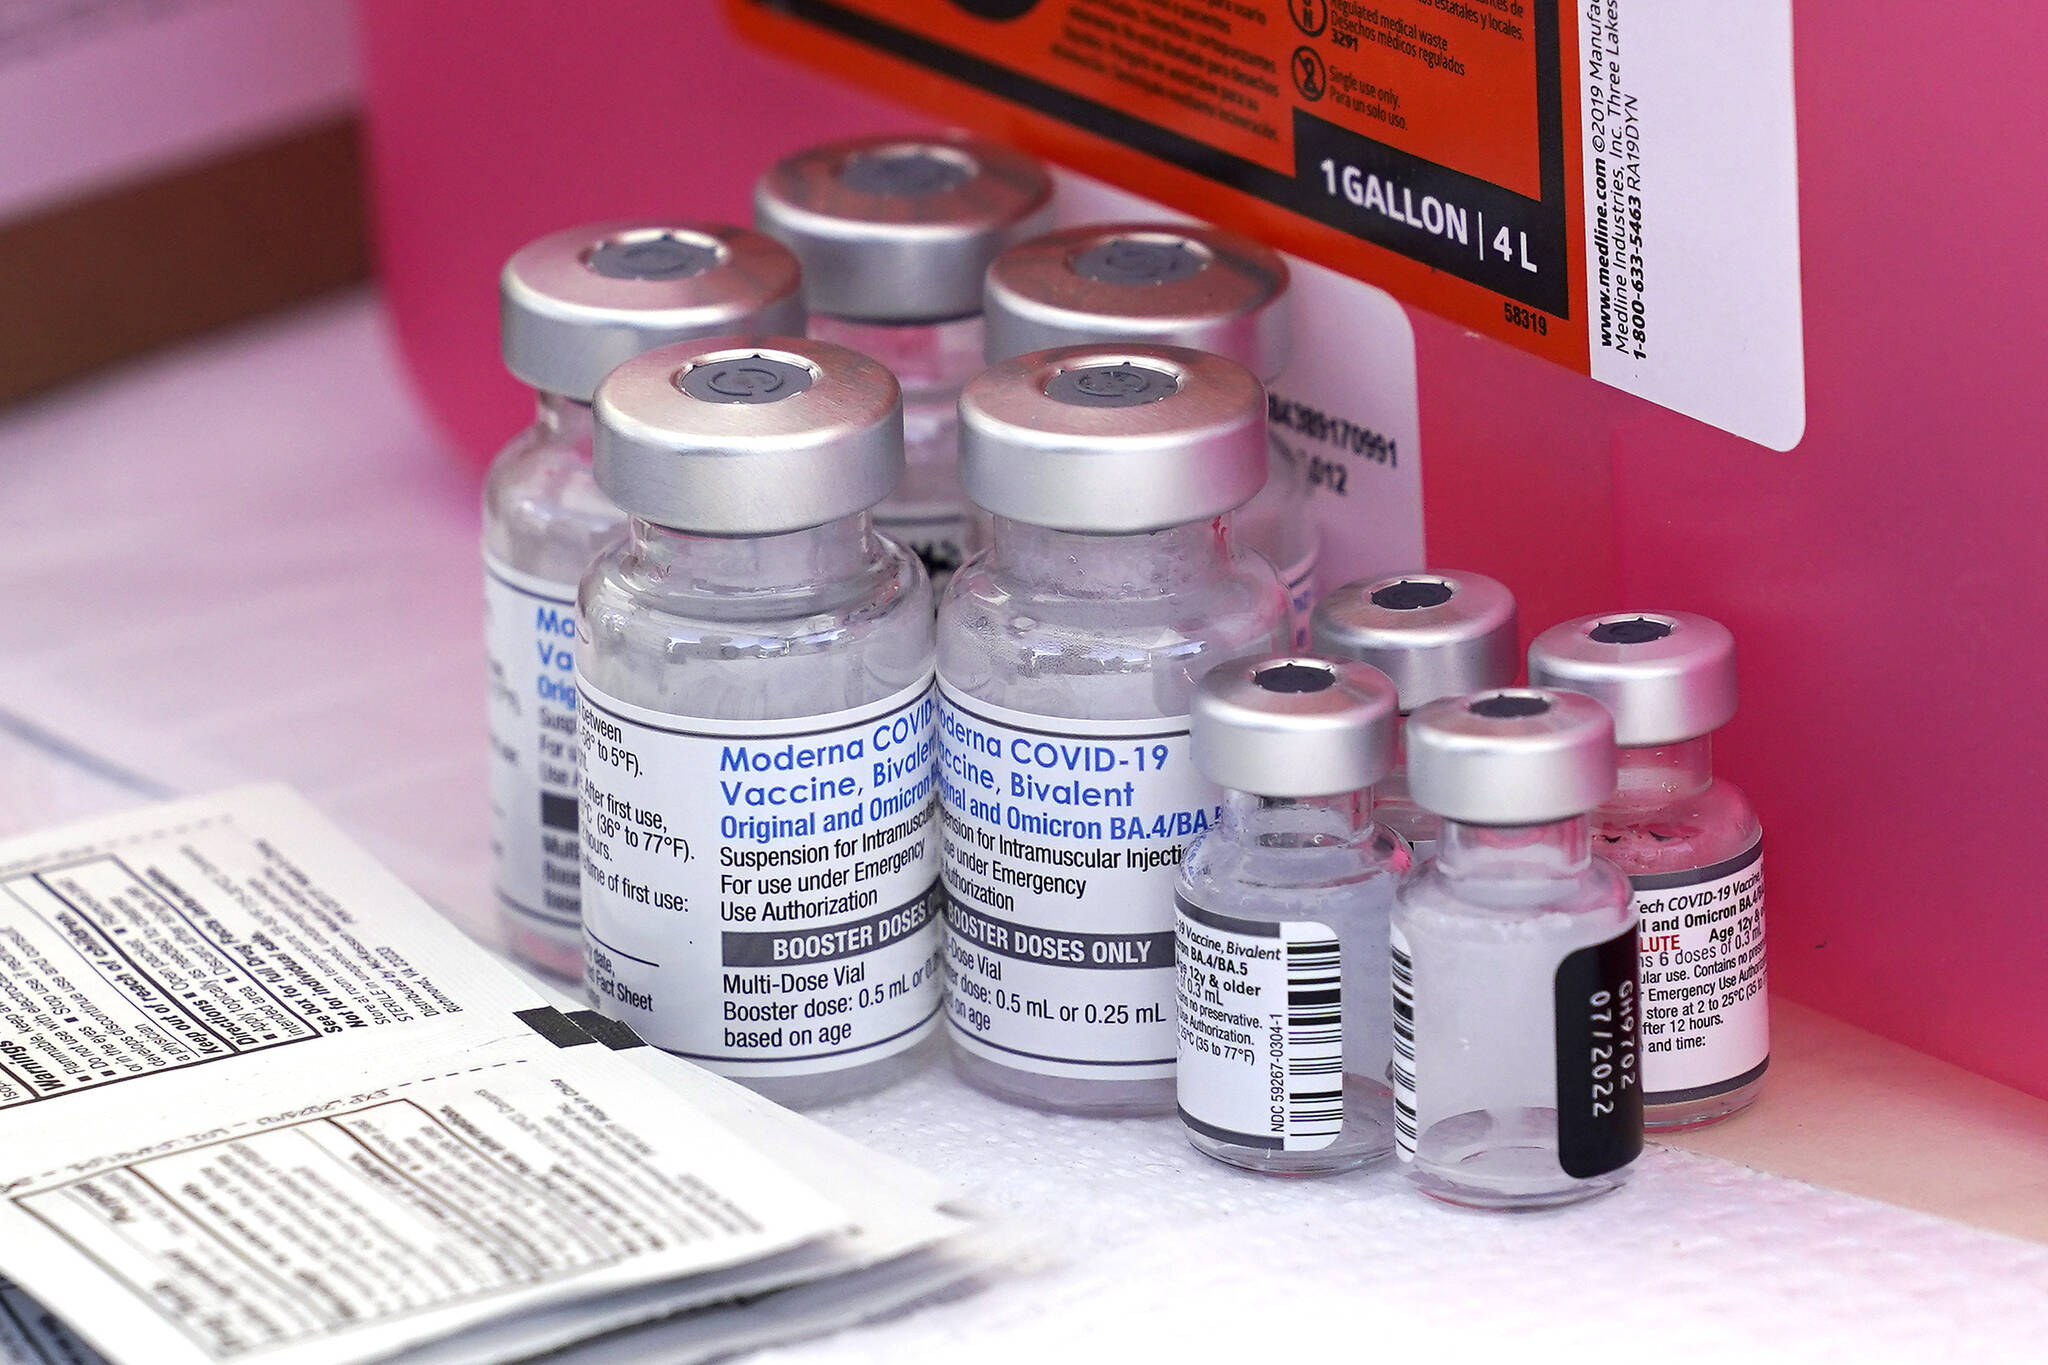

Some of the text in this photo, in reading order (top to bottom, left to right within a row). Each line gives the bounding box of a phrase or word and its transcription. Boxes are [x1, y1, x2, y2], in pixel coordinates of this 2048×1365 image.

[1380, 14, 1448, 51] medical waste
[1418, 47, 1465, 77] regulados
[1329, 65, 1358, 93] Single
[1359, 78, 1376, 98] use
[1607, 62, 1621, 116] Three
[1590, 85, 1606, 153] ©2019
[1609, 126, 1623, 158] Inc.
[1320, 158, 1538, 273] 1 GALLON 4 L
[1611, 166, 1627, 269] Industries,
[1624, 94, 1646, 360] 1-800-633-5463 RA19DYN
[1594, 158, 1612, 347] www.medline.com
[1504, 302, 1547, 336] 58319
[1614, 274, 1630, 354] Medline
[719, 738, 864, 772] Moderna
[940, 707, 1169, 773] oderna COVID-19
[597, 741, 608, 761] to
[611, 747, 643, 778] 5°F).
[939, 740, 1134, 807] accine, Bivalent
[719, 776, 864, 807] Vaccine,
[720, 775, 930, 844] Original and Omicron
[606, 793, 632, 821] first
[635, 808, 667, 833] use,
[970, 797, 1102, 840] and Omicron
[597, 812, 695, 863] (36° to 77°F).
[720, 838, 858, 871] Suspension for
[976, 826, 1121, 870] for Intramuscular
[721, 838, 926, 895] For use under Emergency
[956, 847, 1087, 899] under Emergency
[607, 874, 689, 913] of first use:
[721, 889, 877, 922] Use Authorization
[1668, 885, 1731, 912] COVID-19
[773, 900, 926, 961] BOOSTER DOSES
[947, 900, 1152, 964] BOOSTER DOSES ONLY
[1651, 903, 1737, 932] and Omicron
[1186, 927, 1282, 961] Vaccine, Bivalent
[1639, 934, 1681, 953] LUTE
[1708, 925, 1734, 943] Age
[1659, 952, 1669, 967] 6
[1675, 946, 1717, 966] doses
[1720, 936, 1732, 955] of
[1735, 930, 1750, 950] 0.3
[722, 961, 865, 994] Multi-Dose Vial
[977, 953, 1002, 981] Vial
[1190, 945, 1248, 976] BA.4/BA.5
[1666, 971, 1691, 983] use.
[1693, 959, 1737, 979] Contains
[268, 952, 369, 1028] Not for individual
[616, 982, 654, 1012] Sheet
[724, 1001, 798, 1022] Booster
[804, 996, 853, 1018] dose:
[858, 984, 885, 1009] 0.5
[888, 974, 910, 999] mL
[912, 967, 924, 988] or
[961, 974, 1167, 1024] dose: 0.5 mL or 0.25 mL
[1187, 979, 1224, 1006] 0.3 mL
[1189, 965, 1261, 997] 12y & older
[1648, 976, 1737, 1001] Emergency Use
[114, 973, 224, 1055] Keep out of reach
[254, 967, 344, 1034] See box for full
[968, 1007, 991, 1031] age
[1199, 1005, 1263, 1029] preservative.
[1646, 988, 1745, 1020] store at 2 to 25°C
[54, 1030, 79, 1046] use
[192, 999, 260, 1046] Directions
[724, 1023, 851, 1048] based on age
[1189, 1015, 1255, 1046] Authorization.
[1642, 1012, 1724, 1036] fter 12 hours.
[1196, 1037, 1255, 1066] (35 to 77°F)
[1648, 1035, 1706, 1053] and time:
[2, 1040, 66, 1091] Warnings
[1269, 1013, 1285, 1133] NDC 59267-0304-1
